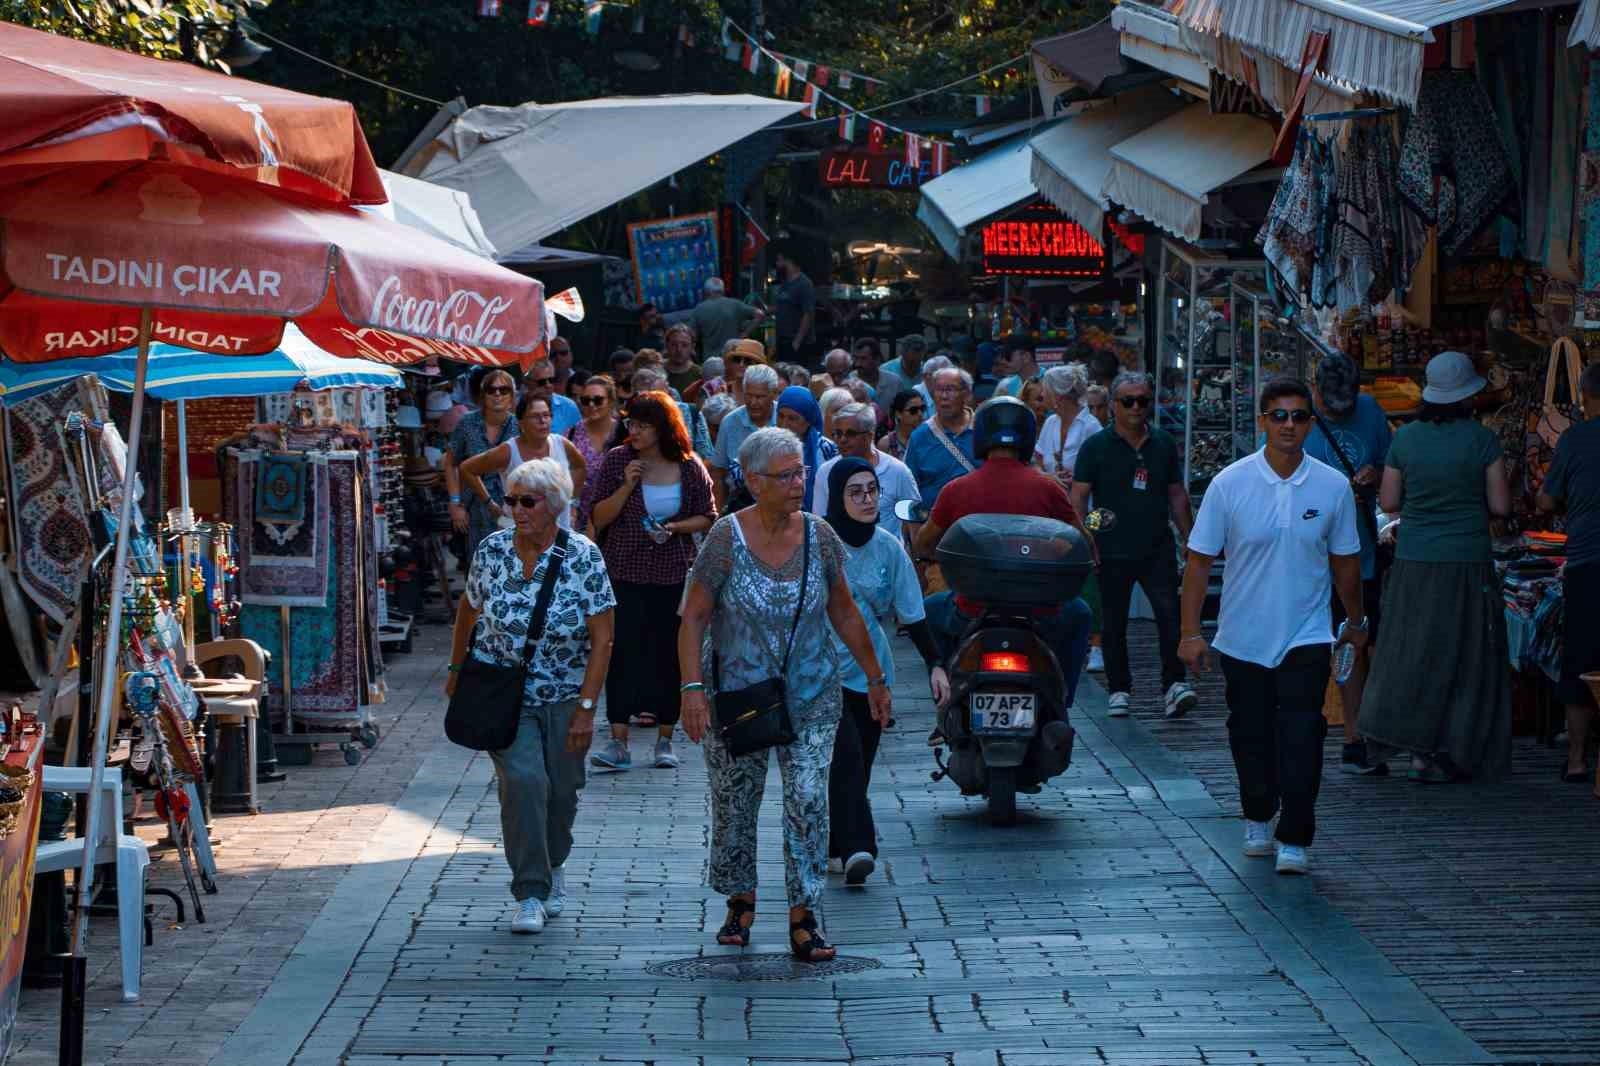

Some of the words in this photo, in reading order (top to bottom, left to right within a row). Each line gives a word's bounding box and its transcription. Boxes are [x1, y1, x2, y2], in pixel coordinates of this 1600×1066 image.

[826, 158, 872, 183] LAL
[888, 160, 939, 186] CAF
[982, 221, 1104, 256] MEERSCHAUM
[45, 253, 163, 289] TADINI
[172, 265, 282, 297] ÇIKAR
[976, 695, 995, 710] 07
[999, 695, 1032, 710] APZ
[990, 711, 1009, 726] 73
